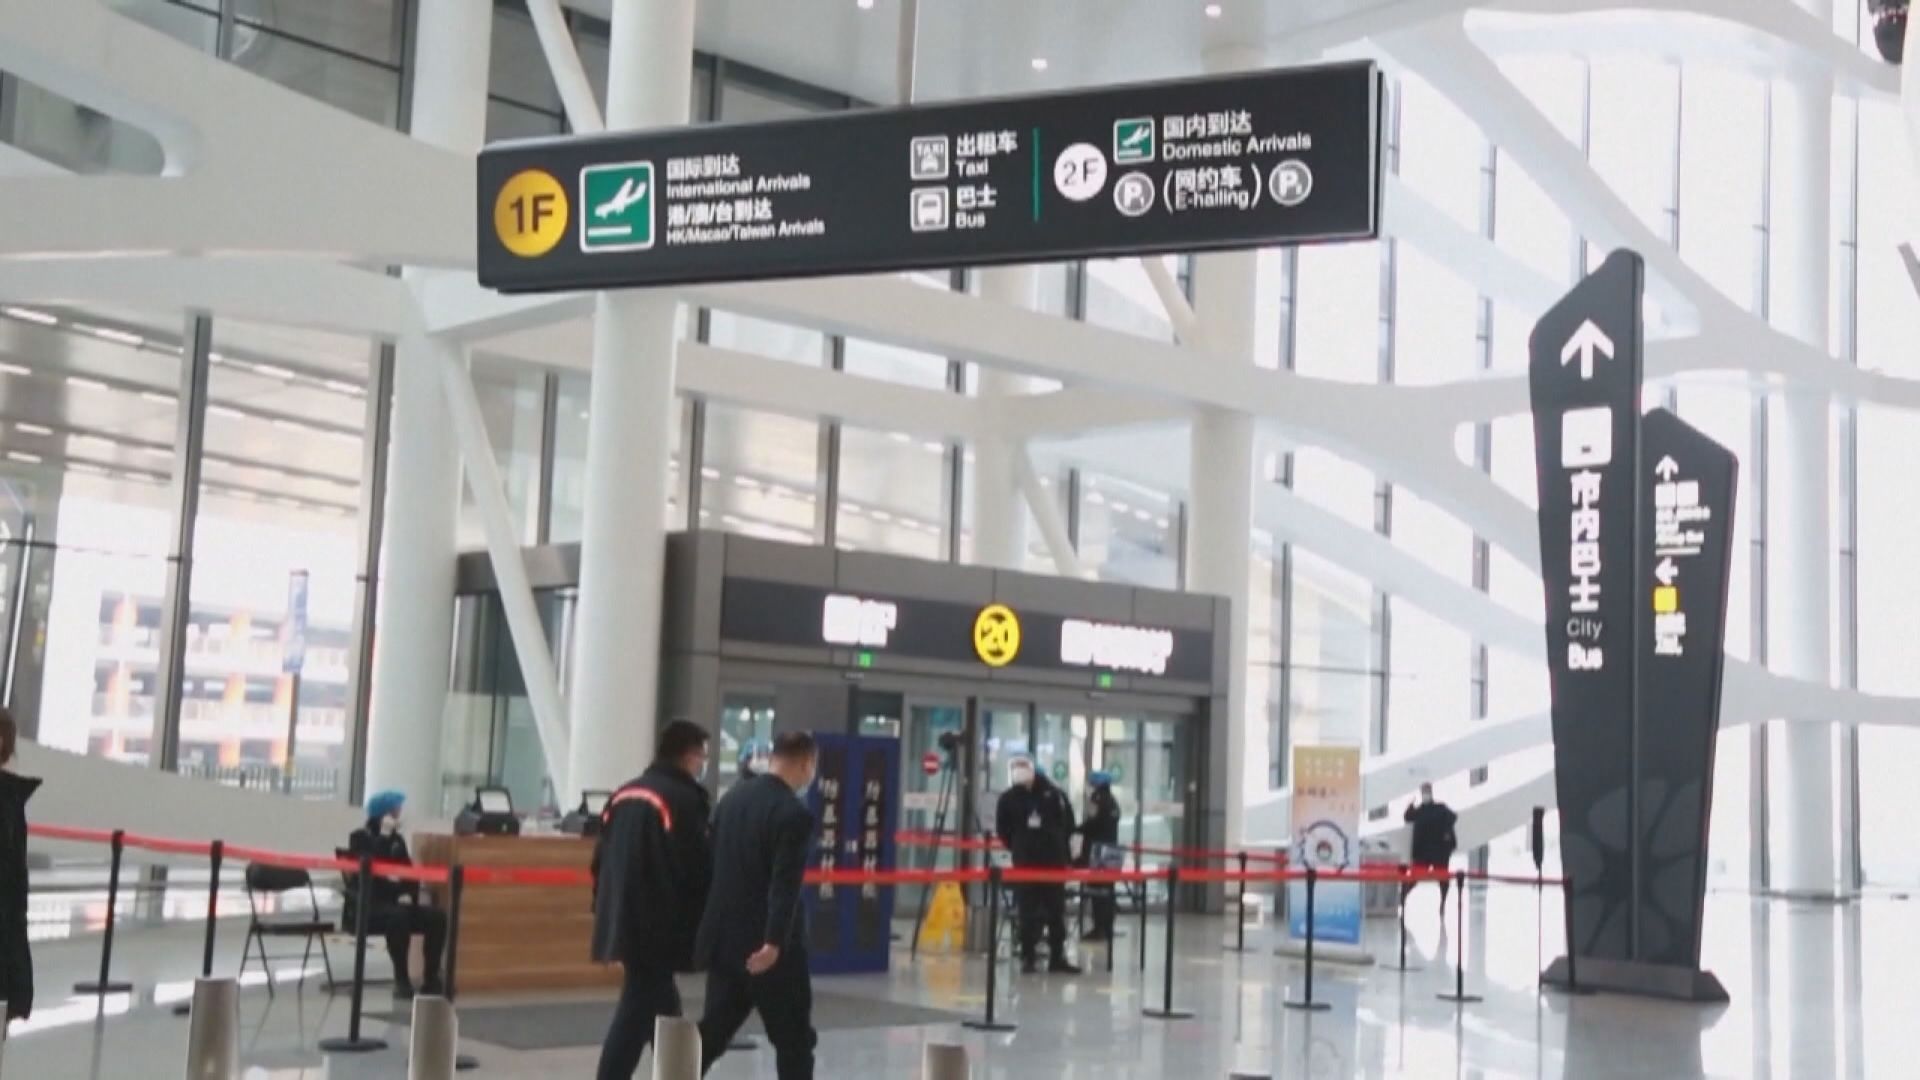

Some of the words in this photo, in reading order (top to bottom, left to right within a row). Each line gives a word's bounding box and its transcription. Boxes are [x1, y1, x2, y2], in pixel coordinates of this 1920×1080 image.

[1163, 109, 1252, 139] 国内到达
[956, 130, 1018, 157] 出租车
[1162, 140, 1242, 162] Domestic
[1246, 132, 1312, 154] Arrivals
[666, 152, 741, 181] 国际到达
[955, 157, 989, 177] Taxi
[1063, 158, 1099, 187] 2F
[666, 178, 753, 199] International
[756, 171, 811, 193] Arrivals
[956, 182, 998, 209] 巴士
[1175, 187, 1249, 211] E-hailing
[510, 193, 555, 234] 1F
[955, 211, 986, 229] Bus
[666, 223, 776, 246] HK/Macao/Taiwan
[778, 217, 825, 237] Arrivals
[1569, 469, 1602, 612] 市内巴士
[1566, 618, 1603, 640] City
[1568, 642, 1603, 671] Bus
